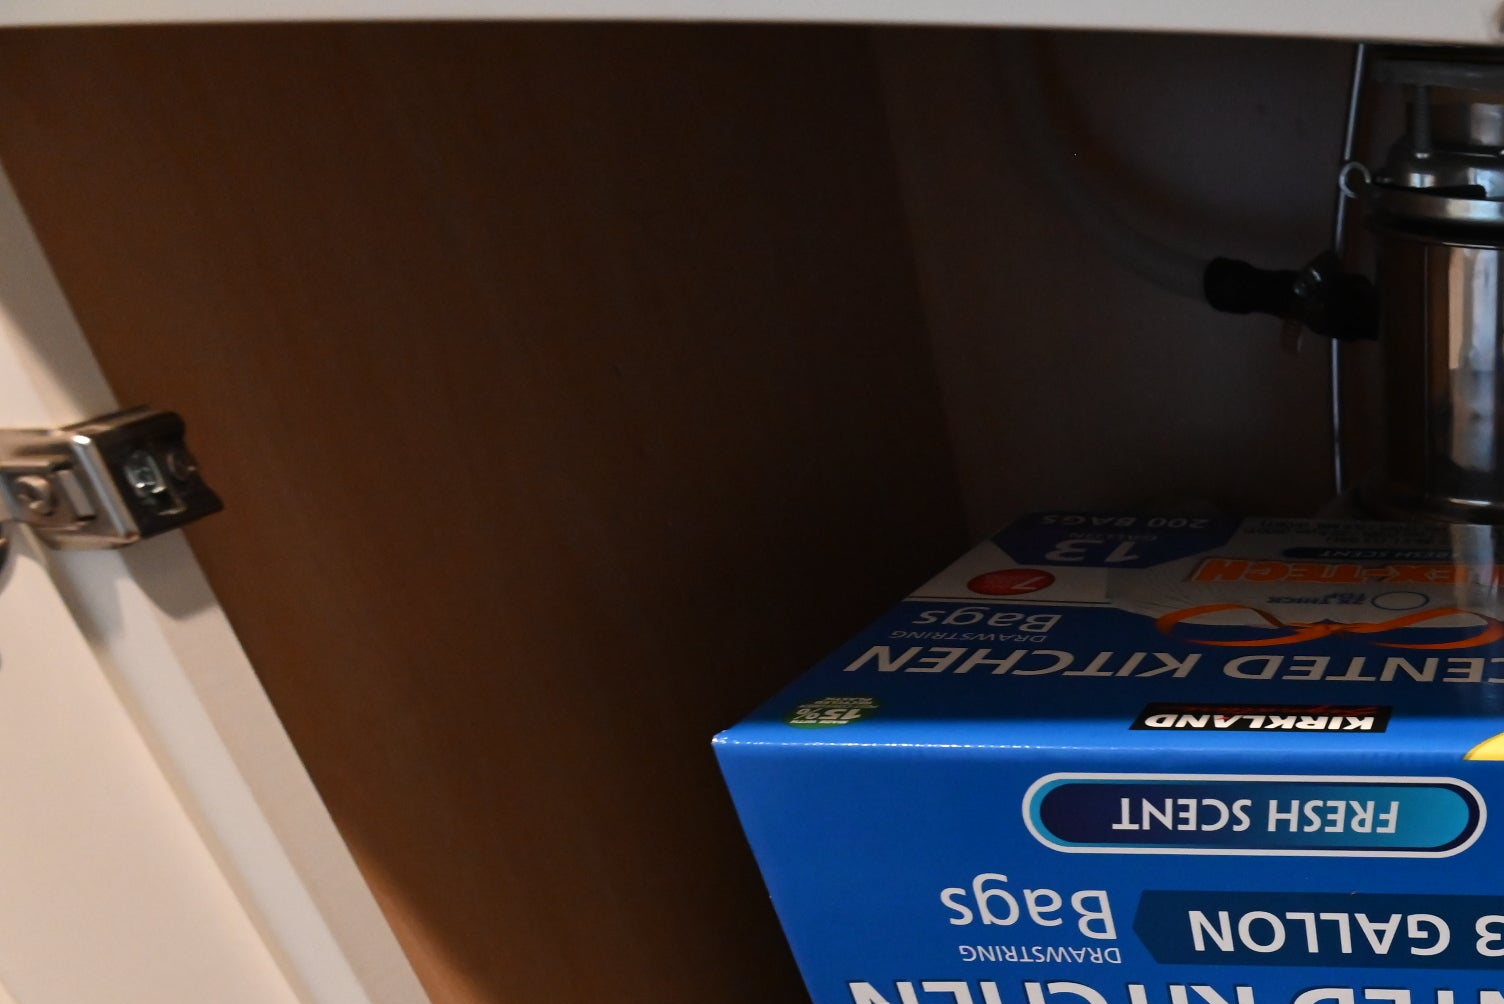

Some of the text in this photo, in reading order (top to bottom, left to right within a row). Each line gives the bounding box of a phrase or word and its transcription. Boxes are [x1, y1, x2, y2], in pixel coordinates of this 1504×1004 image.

[1040, 513, 1138, 528] BAGS
[1044, 538, 1140, 563] 13
[1011, 575, 1047, 591] 7
[911, 606, 1063, 633] Bags
[887, 630, 1049, 643] DRAWSTRING
[842, 645, 1203, 678] KITCHEN
[793, 708, 862, 720] 15%
[1145, 714, 1376, 731] KIRKLAND
[1112, 797, 1401, 834] FRESH SCENT
[940, 874, 1118, 941] Bags
[1188, 908, 1451, 956] GALLON
[958, 942, 1122, 965] DRAWSTRING
